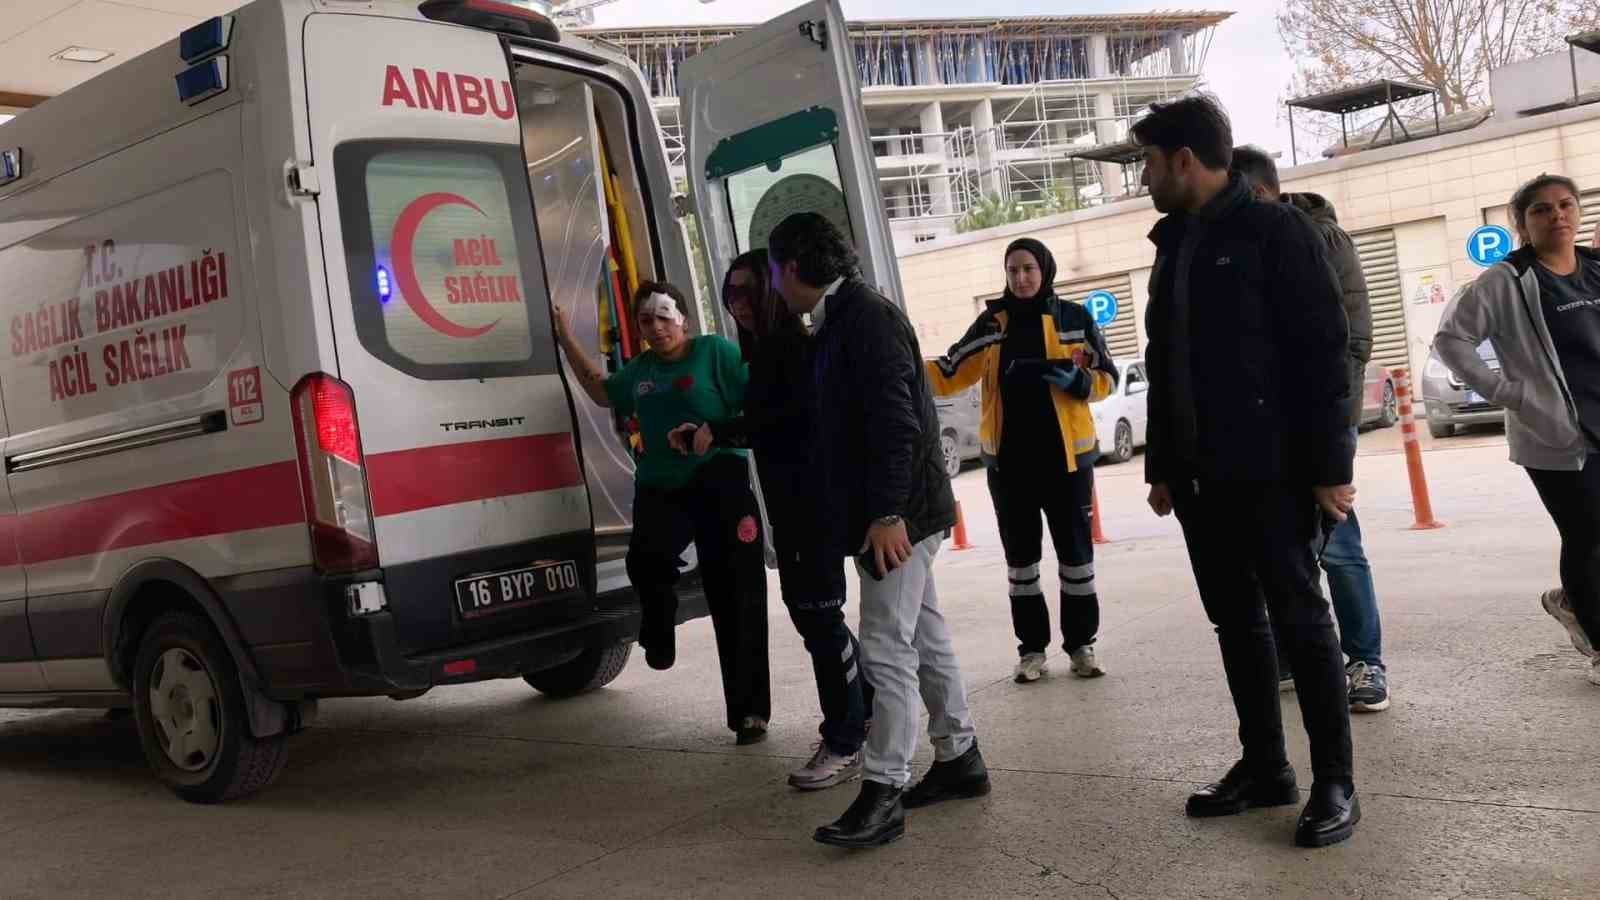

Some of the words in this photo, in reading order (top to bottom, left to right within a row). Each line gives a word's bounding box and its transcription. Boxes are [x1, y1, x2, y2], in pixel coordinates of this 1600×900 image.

[382, 64, 515, 120] AMBU
[453, 234, 502, 266] ACİL
[1478, 232, 1500, 260] P
[82, 239, 123, 287] T.C.
[10, 297, 83, 356] SAĞLIK
[96, 248, 229, 333] BAKANLIĞI
[445, 271, 521, 304] SAĞLIK
[1092, 296, 1108, 320] P
[50, 346, 98, 402] ACİL
[103, 324, 191, 387] SAĞLIK
[233, 374, 257, 402] 112
[440, 416, 525, 431] TRANSIT
[469, 581, 491, 608] 16
[500, 570, 536, 602] BYP
[545, 564, 576, 592] 010
